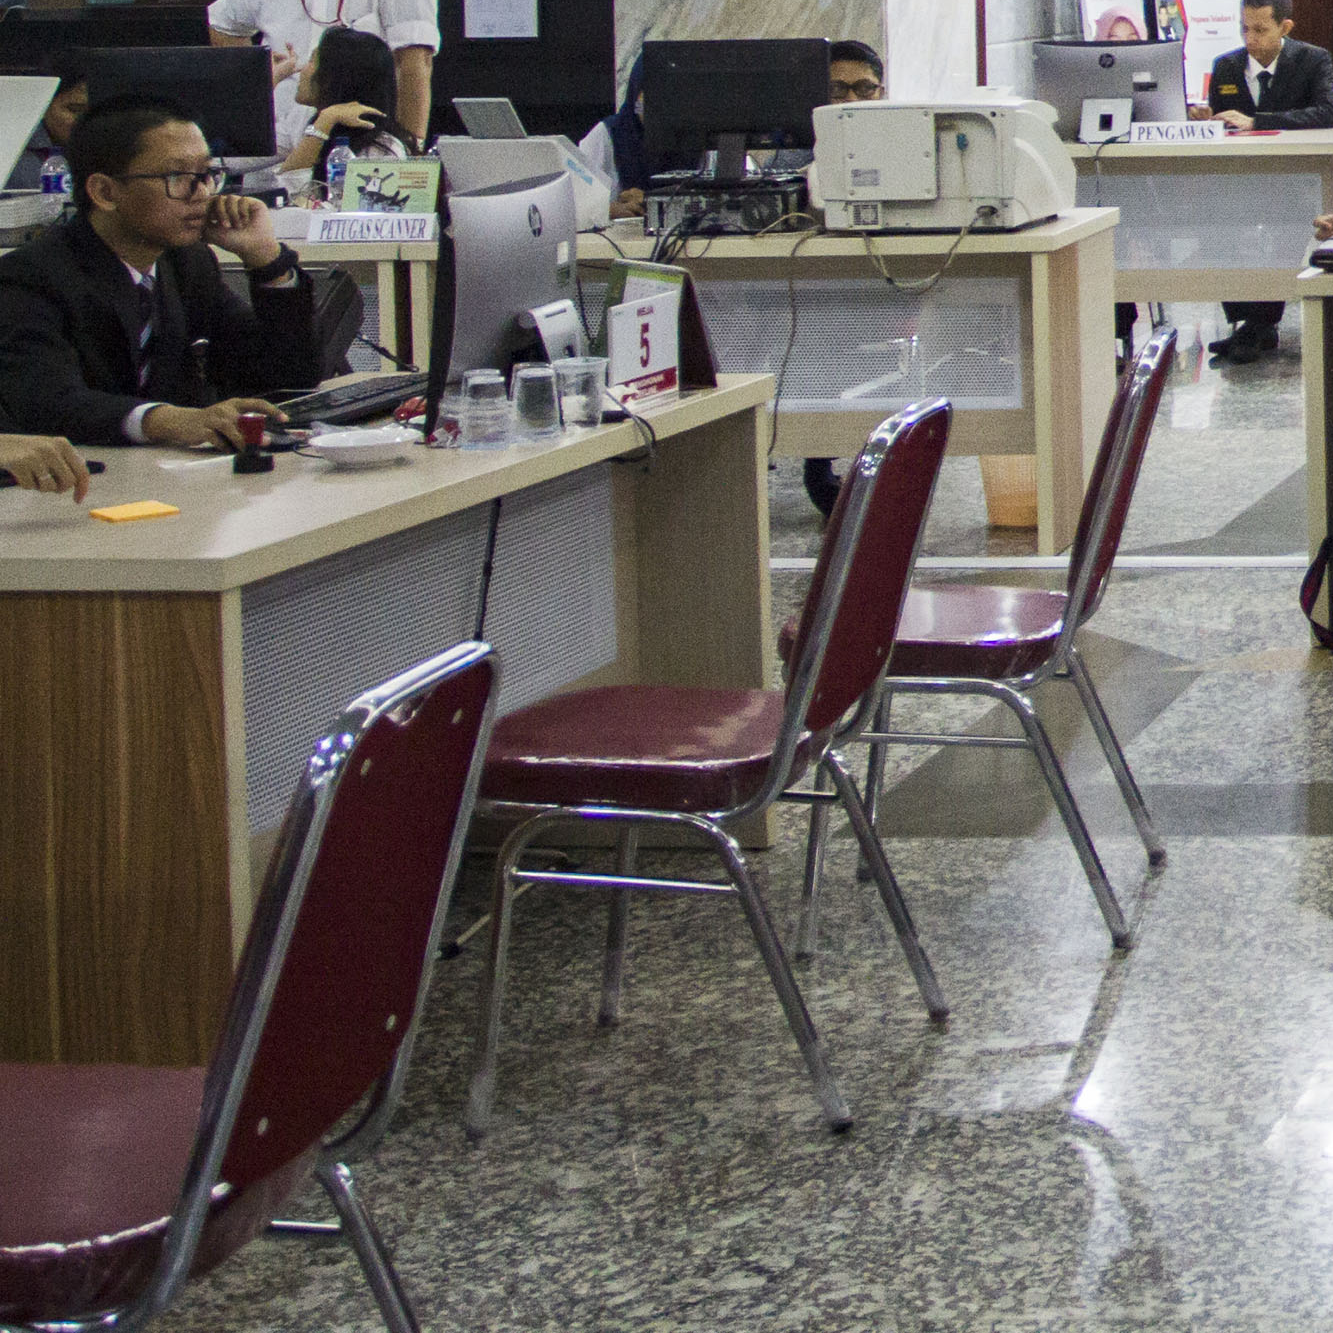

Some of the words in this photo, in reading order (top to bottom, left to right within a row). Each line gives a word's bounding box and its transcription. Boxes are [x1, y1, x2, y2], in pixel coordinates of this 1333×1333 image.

[1137, 125, 1215, 141] PENGAWAS
[319, 218, 372, 240] PETUGAS
[373, 218, 427, 240] SCANNER
[640, 322, 650, 368] 5
